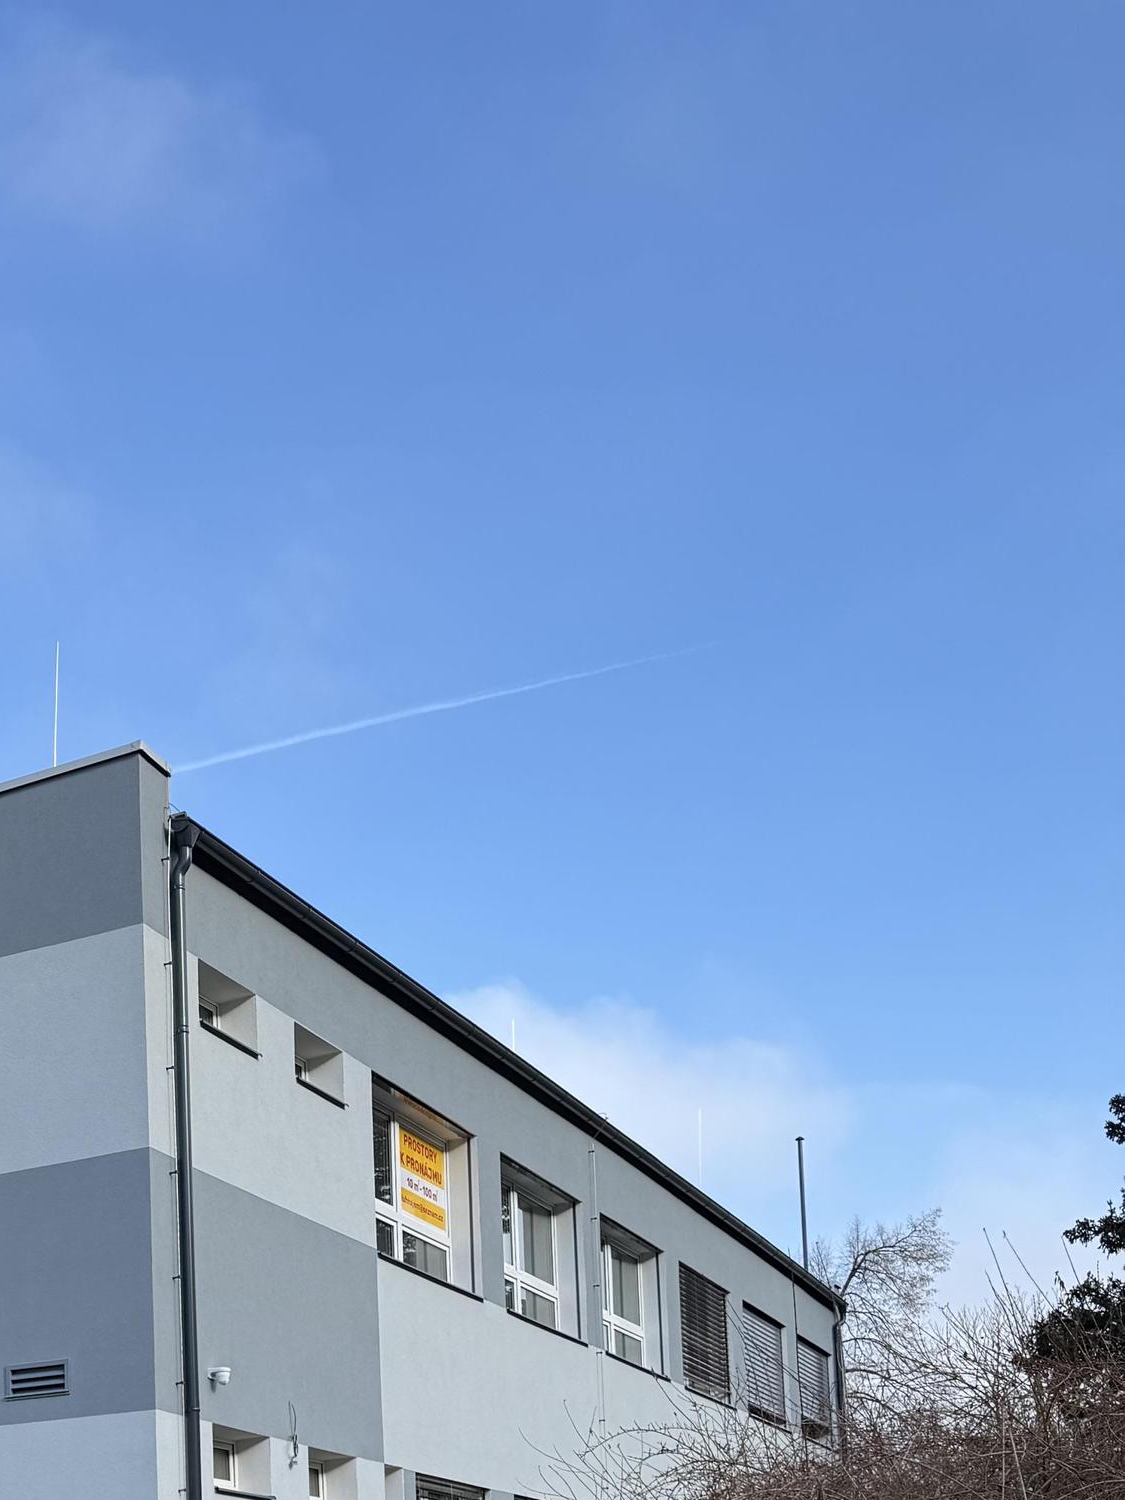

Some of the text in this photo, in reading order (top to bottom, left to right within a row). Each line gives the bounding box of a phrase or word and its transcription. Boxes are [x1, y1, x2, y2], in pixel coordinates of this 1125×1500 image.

[403, 1134, 437, 1164] PROSTORY
[400, 1151, 442, 1185] K PRONÁJMU
[407, 1178, 413, 1189] 10
[422, 1186, 432, 1199] 100
